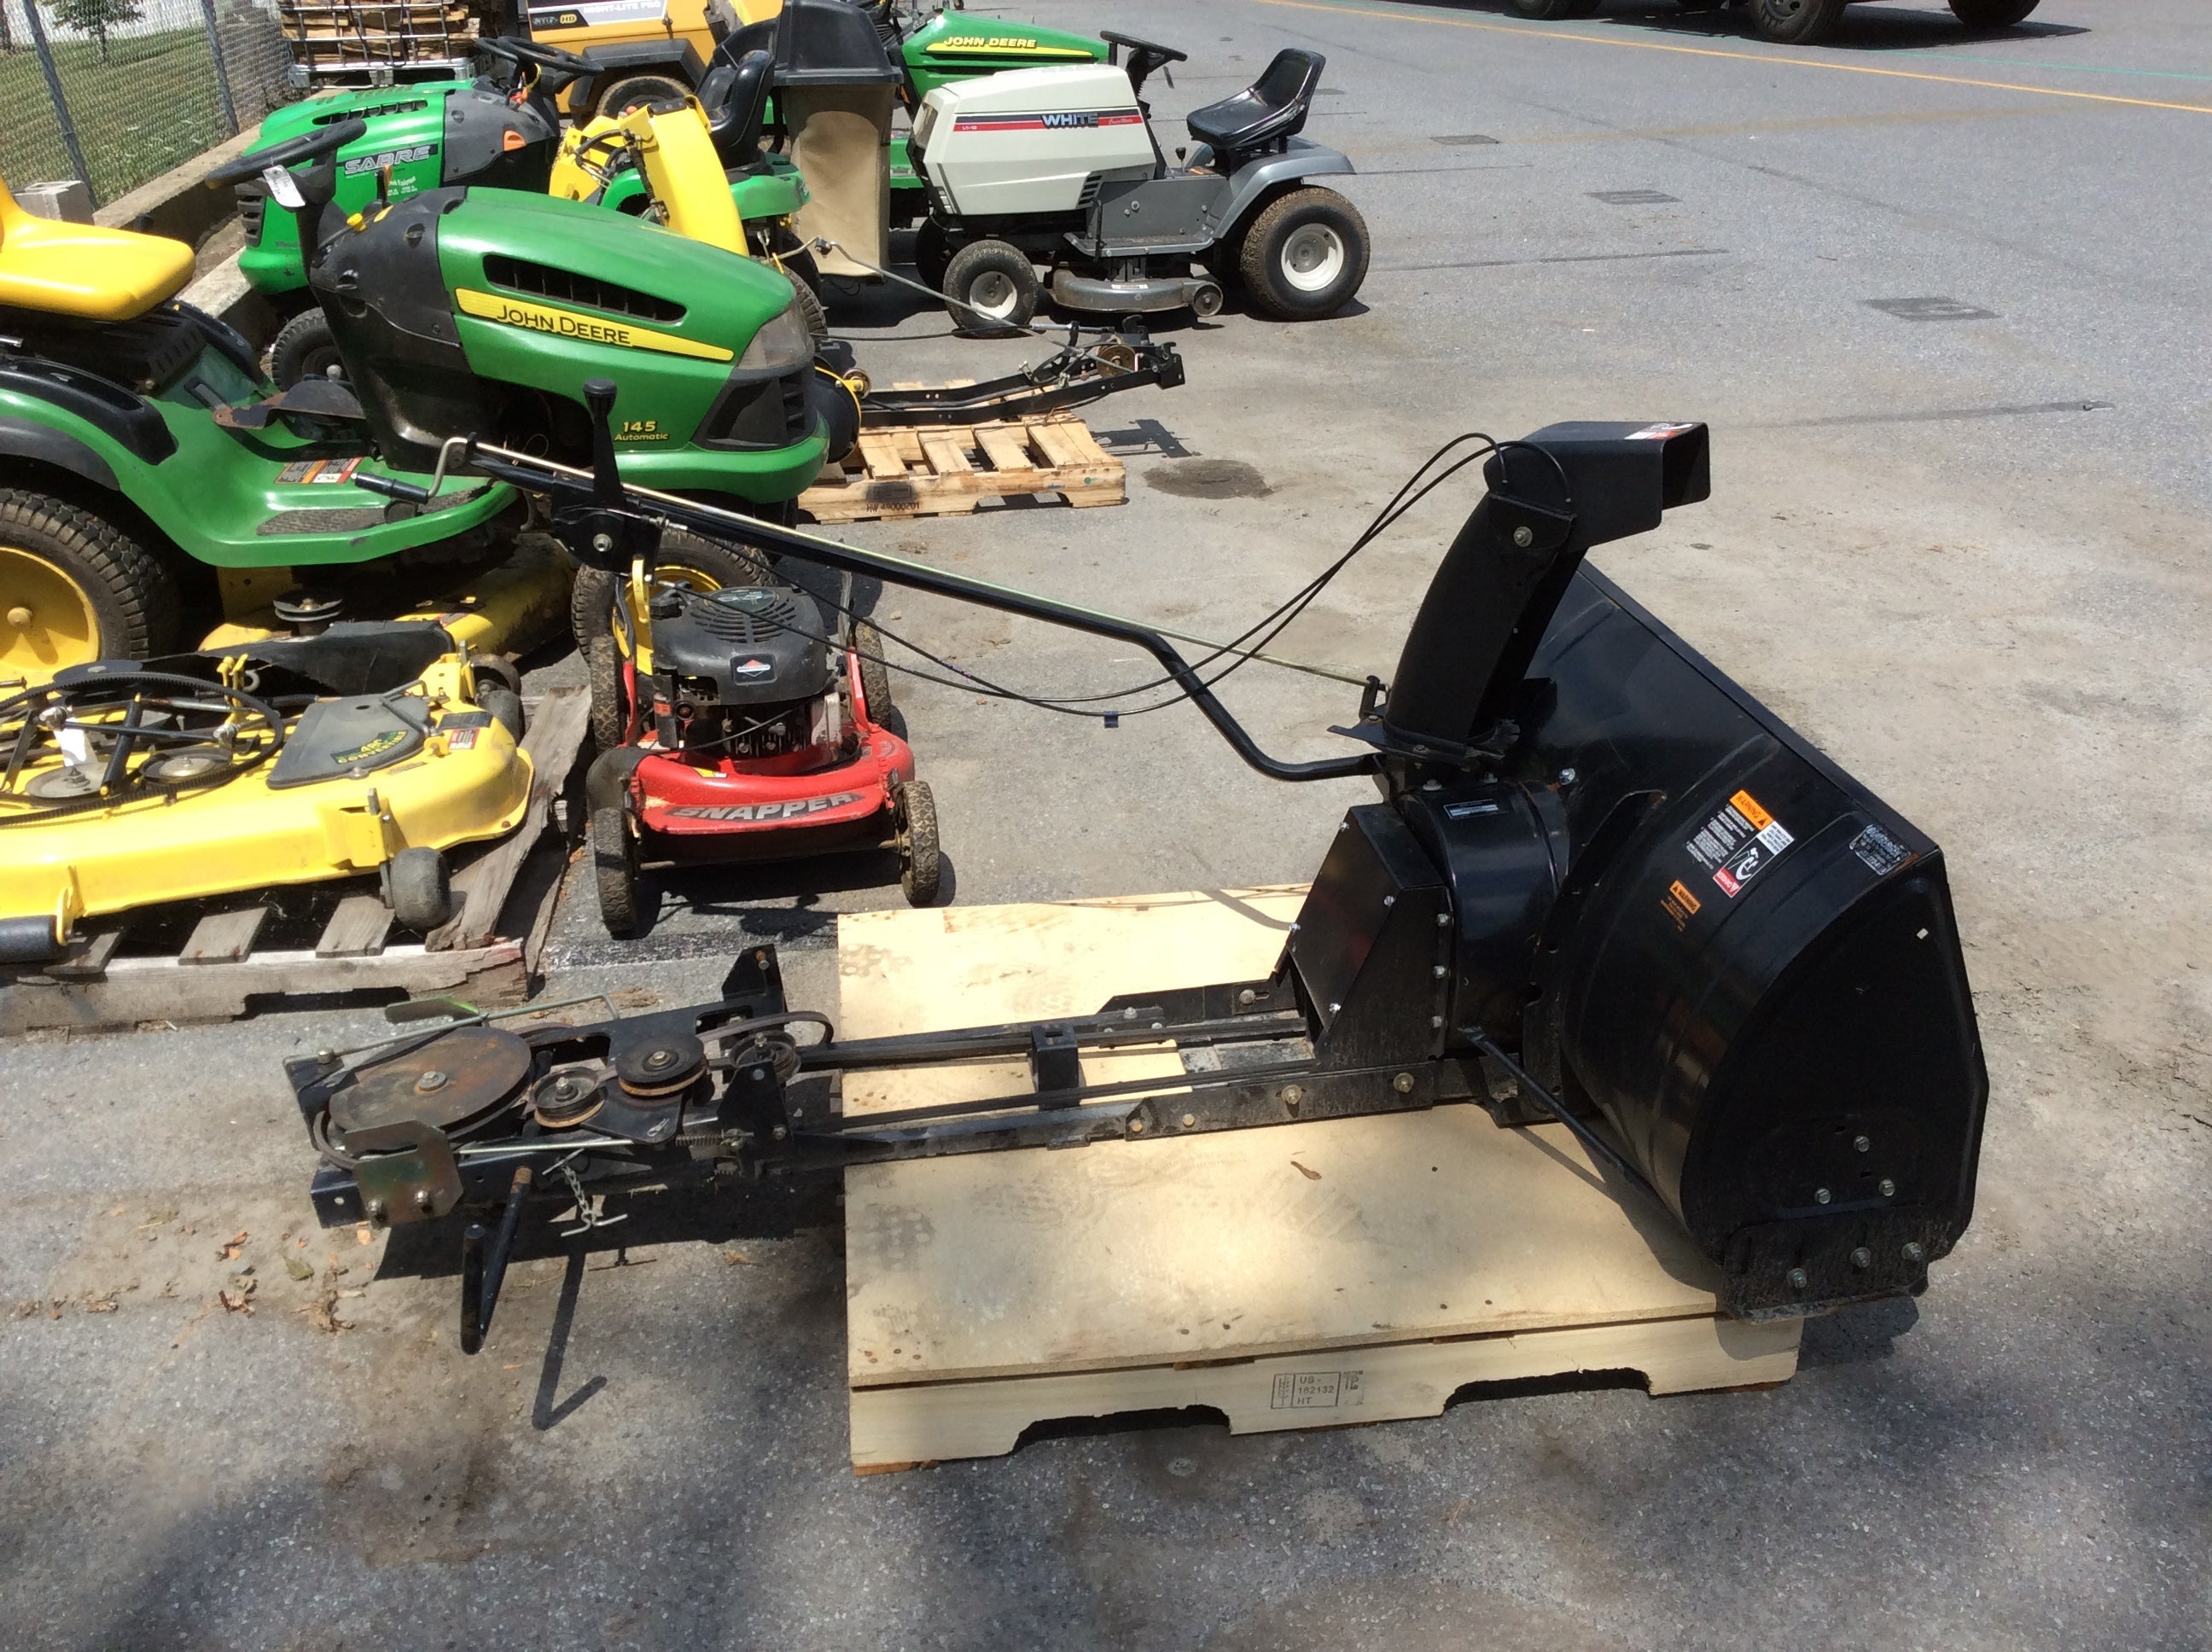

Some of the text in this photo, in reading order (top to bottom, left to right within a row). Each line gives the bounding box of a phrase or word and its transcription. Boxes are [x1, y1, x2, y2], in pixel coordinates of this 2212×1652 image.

[584, 1, 661, 14] NIGHT-LITE PRO
[561, 15, 576, 23] HD
[944, 37, 1037, 49] JOHN DEERE
[1041, 113, 1099, 129] WHITE
[345, 145, 431, 175] SABRE
[497, 305, 631, 345] JOHN DEERE
[623, 421, 656, 433] 145
[614, 433, 668, 441] Automatic
[673, 794, 854, 820] SNAPPER
[1735, 794, 1761, 819] WARNING
[1299, 1376, 1315, 1384] US
